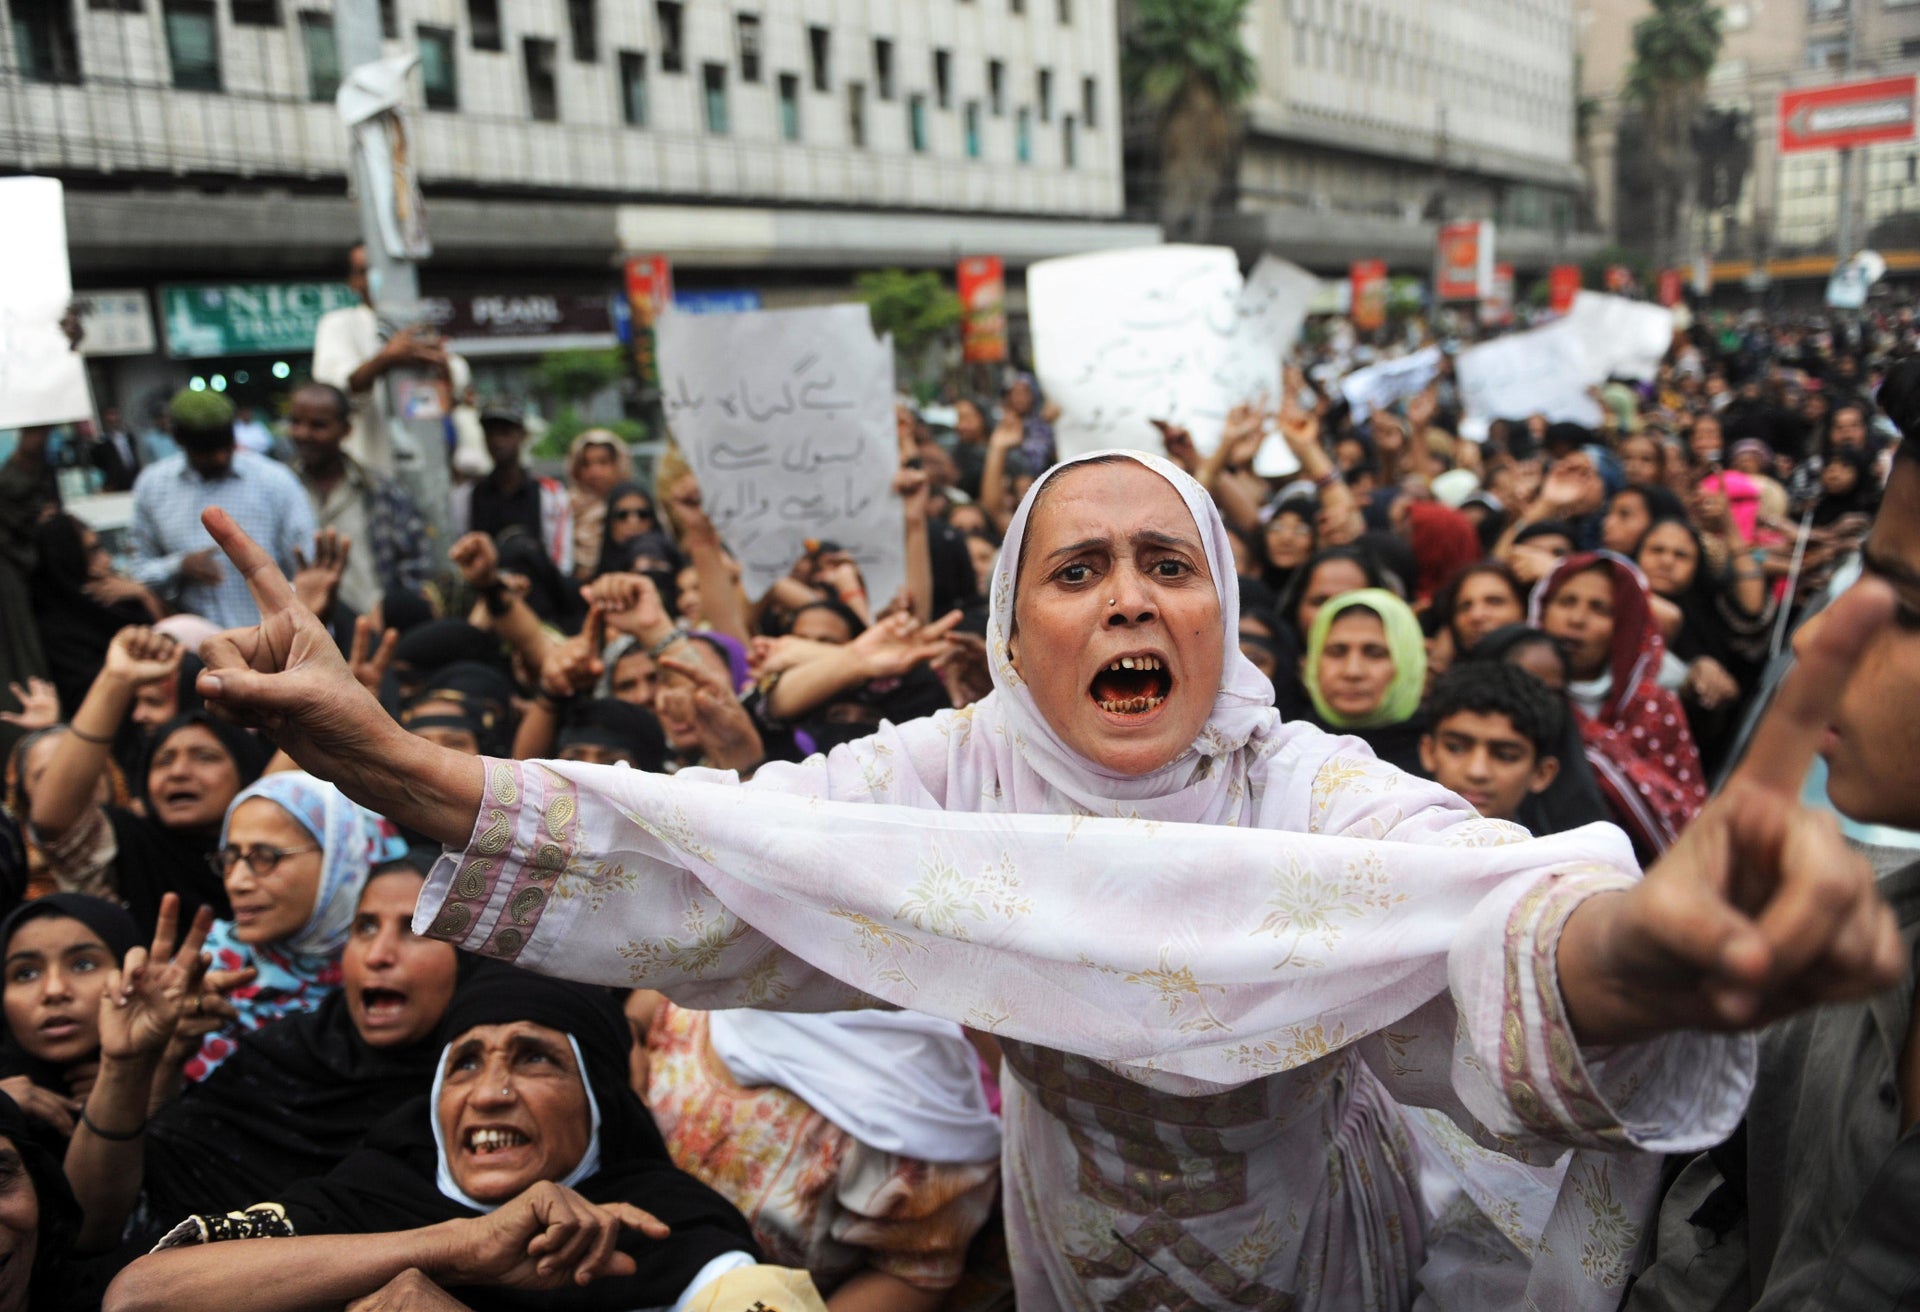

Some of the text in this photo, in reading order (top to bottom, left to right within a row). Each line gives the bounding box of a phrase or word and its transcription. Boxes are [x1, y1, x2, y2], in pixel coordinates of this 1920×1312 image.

[228, 283, 352, 316] NICE
[472, 298, 562, 323] PEARL
[234, 318, 315, 341] TRAVE
